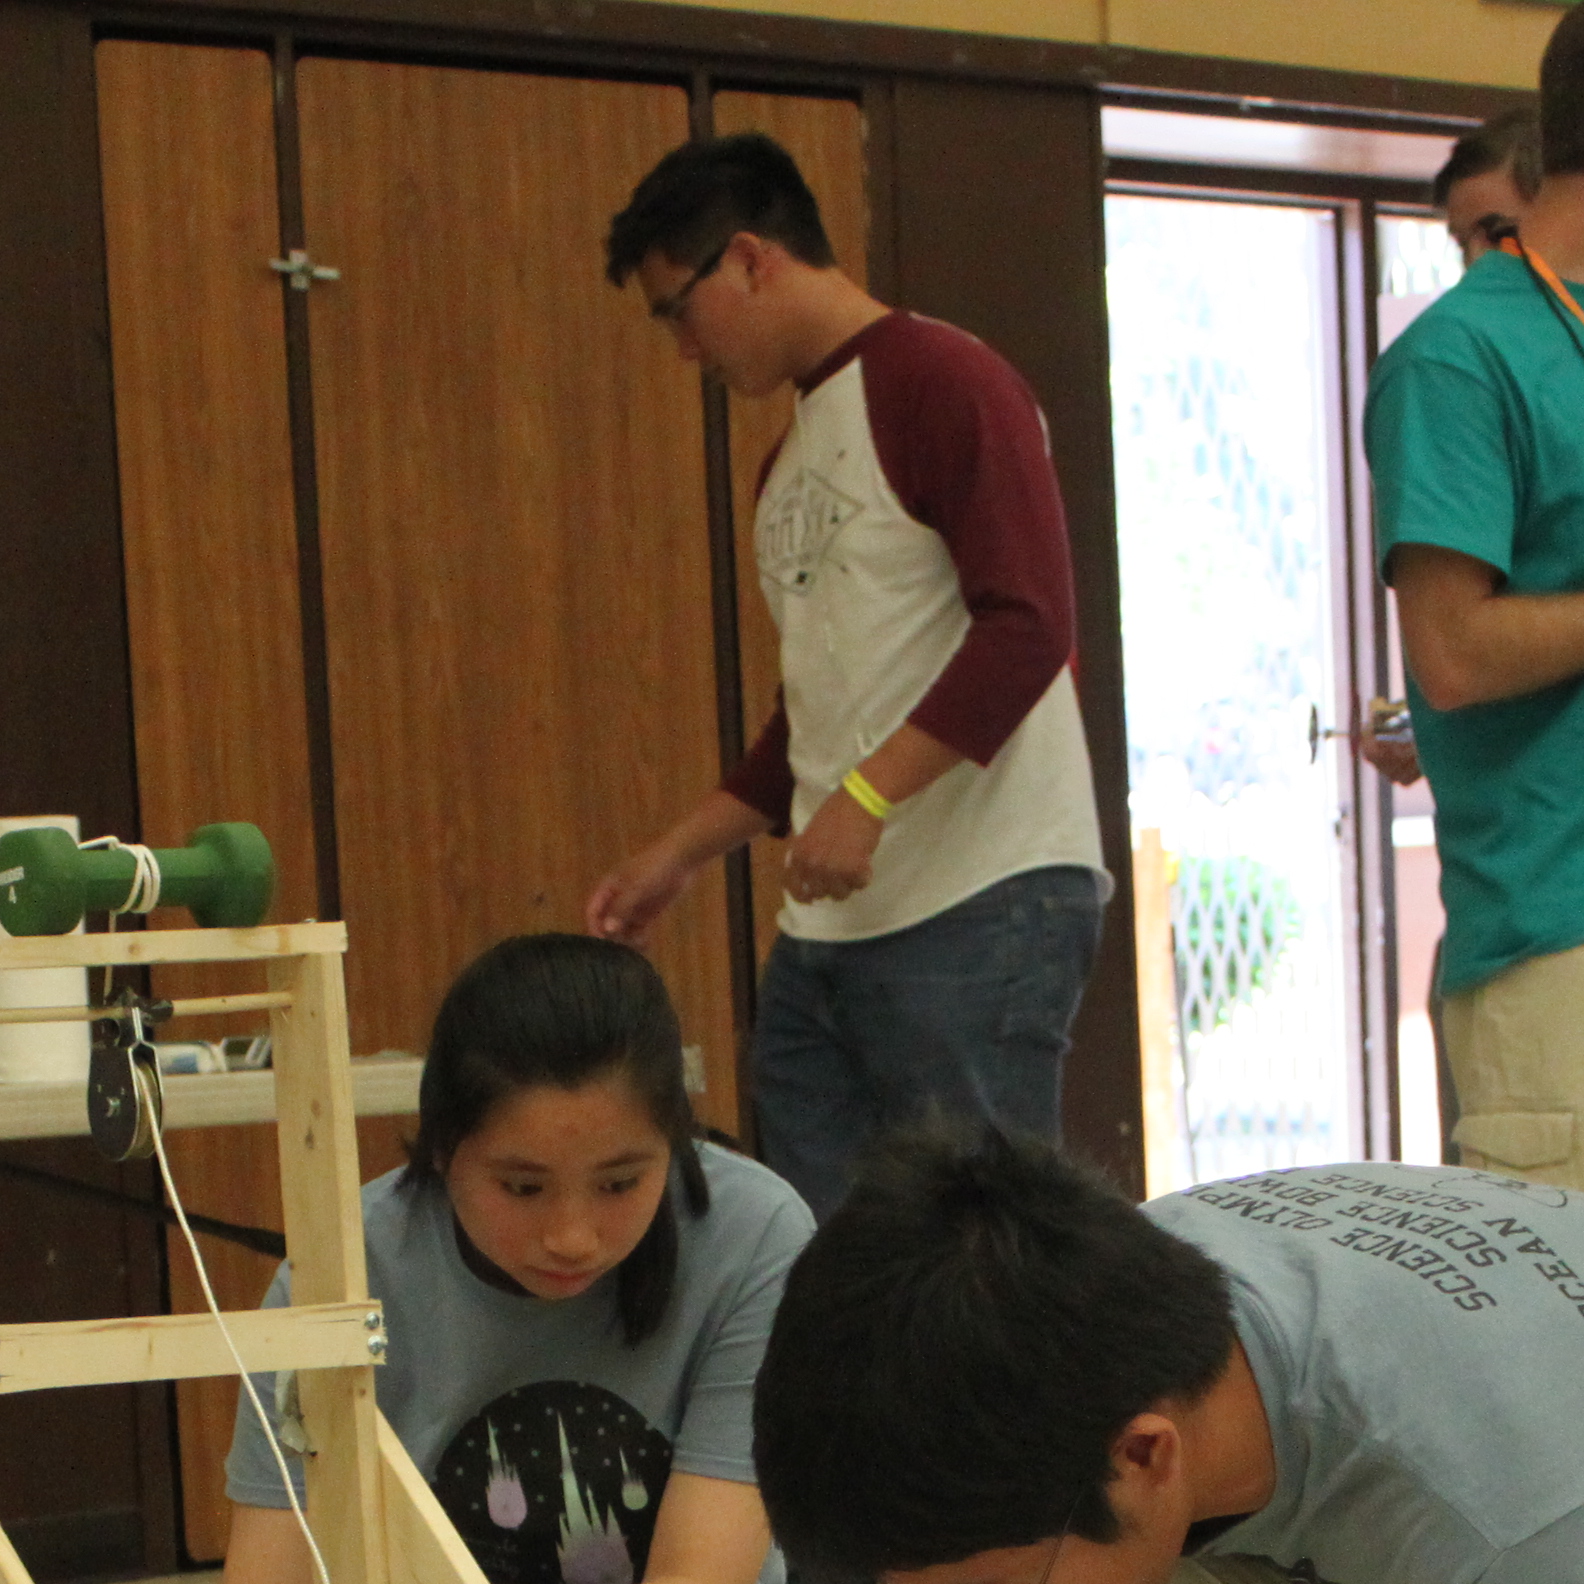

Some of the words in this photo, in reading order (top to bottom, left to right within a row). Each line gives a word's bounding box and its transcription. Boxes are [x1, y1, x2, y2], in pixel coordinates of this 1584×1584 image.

[1309, 1172, 1485, 1213] SCIENCE
[1335, 1200, 1508, 1268] SCIENCE
[1329, 1226, 1498, 1312] SCIENCE
